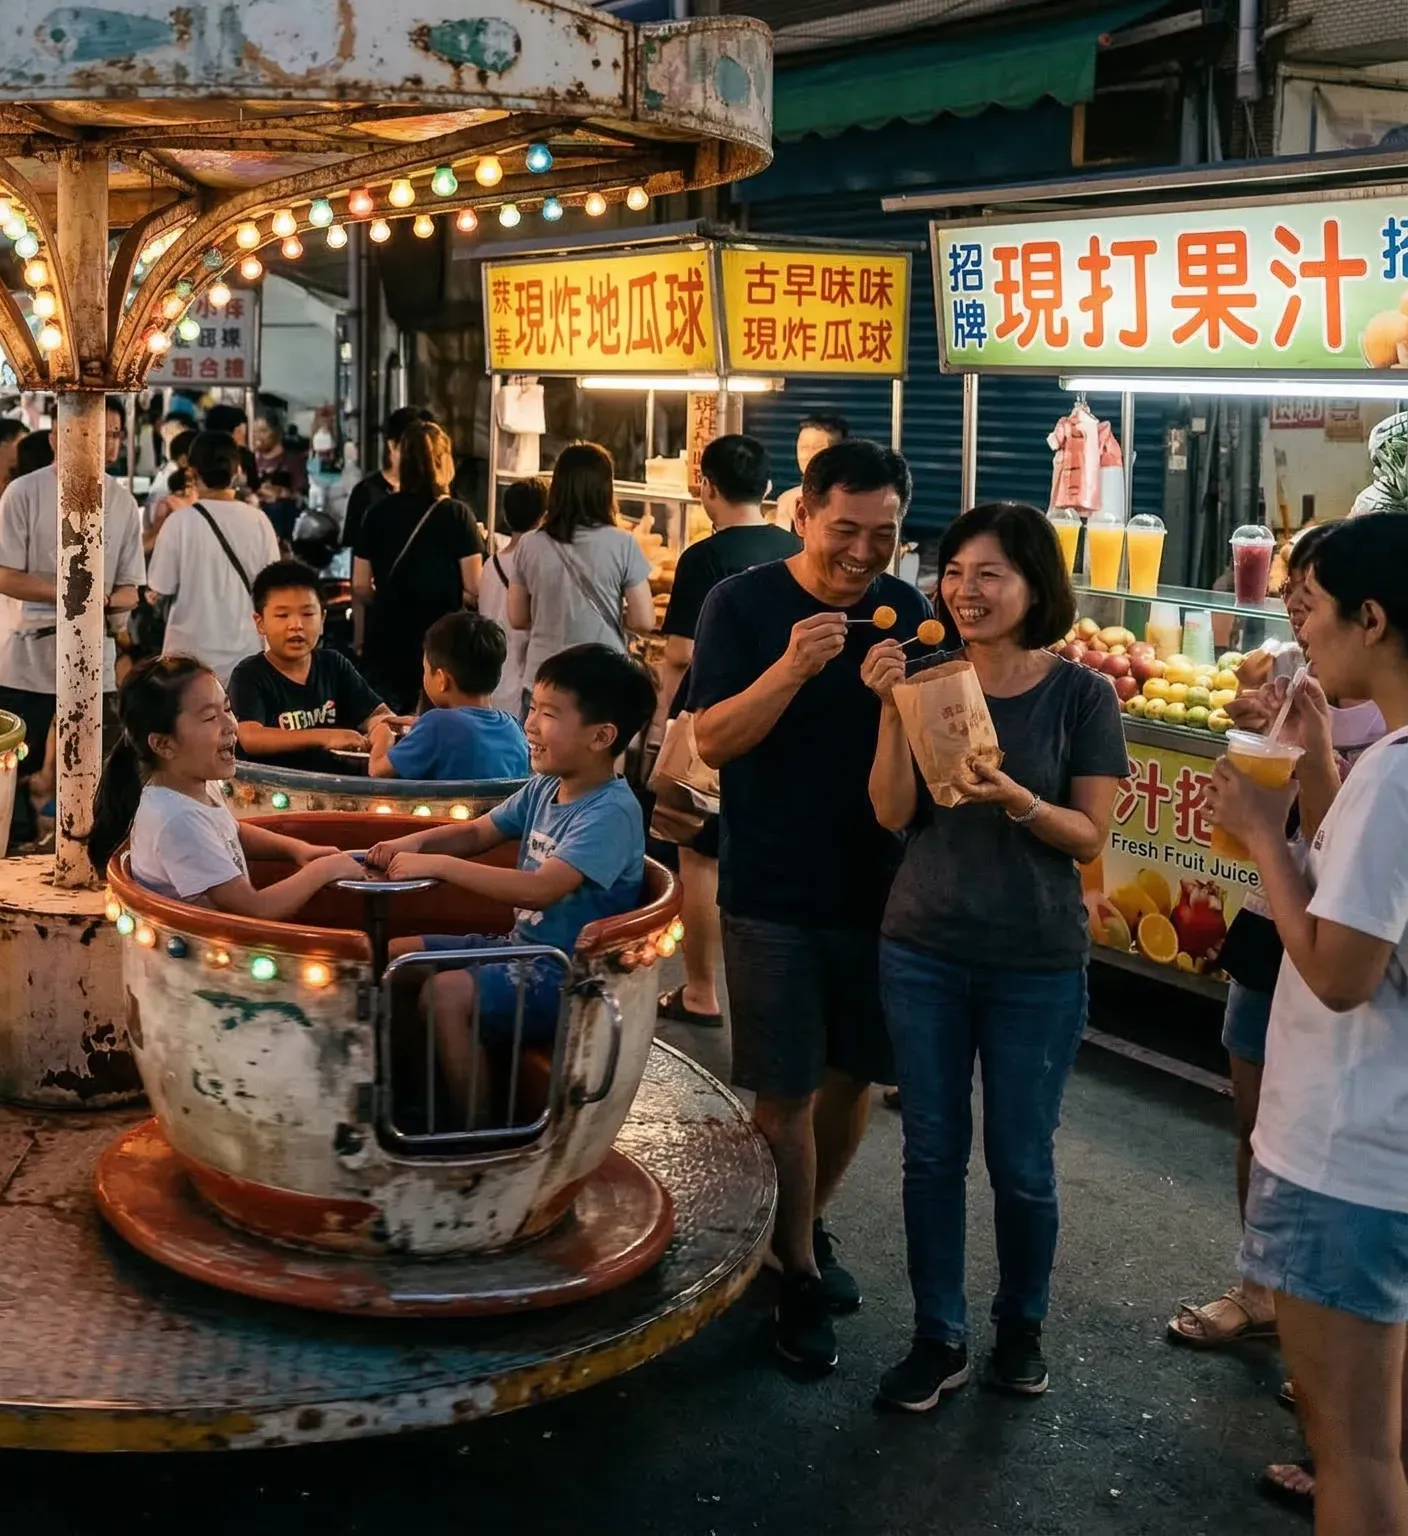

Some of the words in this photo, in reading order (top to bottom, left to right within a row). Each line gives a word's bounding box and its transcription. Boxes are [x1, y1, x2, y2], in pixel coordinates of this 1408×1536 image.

[513, 263, 707, 357] 現炸地瓜球
[745, 261, 894, 311] 古早味味
[949, 243, 987, 349] 招牌
[992, 219, 1367, 349] 現打果汁
[742, 316, 893, 364] 現炸瓜球
[1111, 832, 1158, 859] Fresh
[1164, 846, 1205, 873] Fruit
[1209, 858, 1260, 887] Juice
